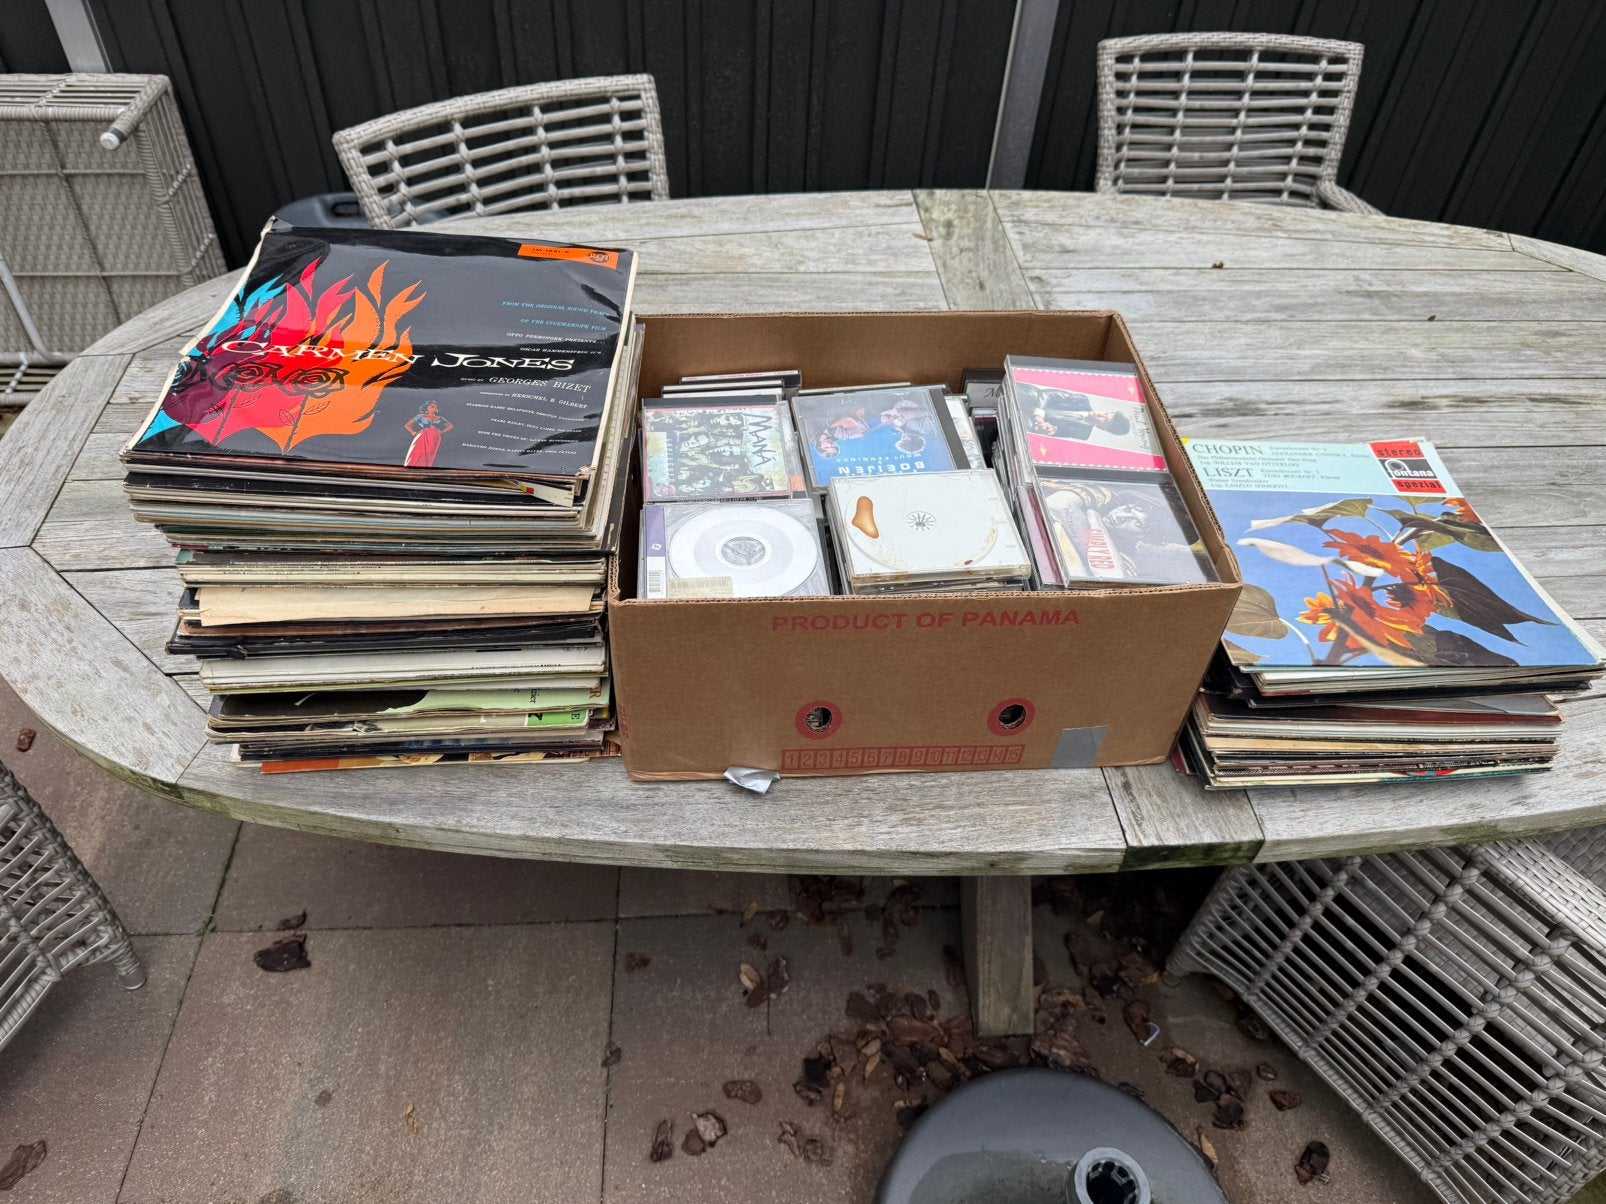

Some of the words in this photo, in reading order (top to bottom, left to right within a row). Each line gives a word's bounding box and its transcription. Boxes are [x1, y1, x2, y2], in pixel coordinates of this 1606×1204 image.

[222, 340, 424, 366] CARMEN
[430, 353, 575, 371] JONES
[489, 376, 548, 387] GEORGES
[552, 381, 592, 393] BIZET
[558, 400, 589, 409] GILBERT
[1192, 443, 1263, 455] CHOPIN
[1377, 447, 1423, 457] stereo
[838, 461, 925, 475] BOEIJEN
[1203, 467, 1253, 478] LISZT
[1385, 461, 1435, 479] fontana
[1396, 479, 1443, 490] spezial
[772, 613, 907, 632] PRODUCT
[915, 613, 954, 628] OF
[960, 609, 1080, 628] PANAMA
[787, 753, 796, 766] 1
[802, 753, 811, 766] 2
[818, 753, 827, 765] 3
[833, 752, 844, 765] 4
[850, 751, 859, 764] 5
[866, 751, 875, 764] 6
[882, 751, 891, 764] 7
[898, 750, 906, 764] 8
[914, 750, 923, 763] 9
[929, 749, 940, 763] 10
